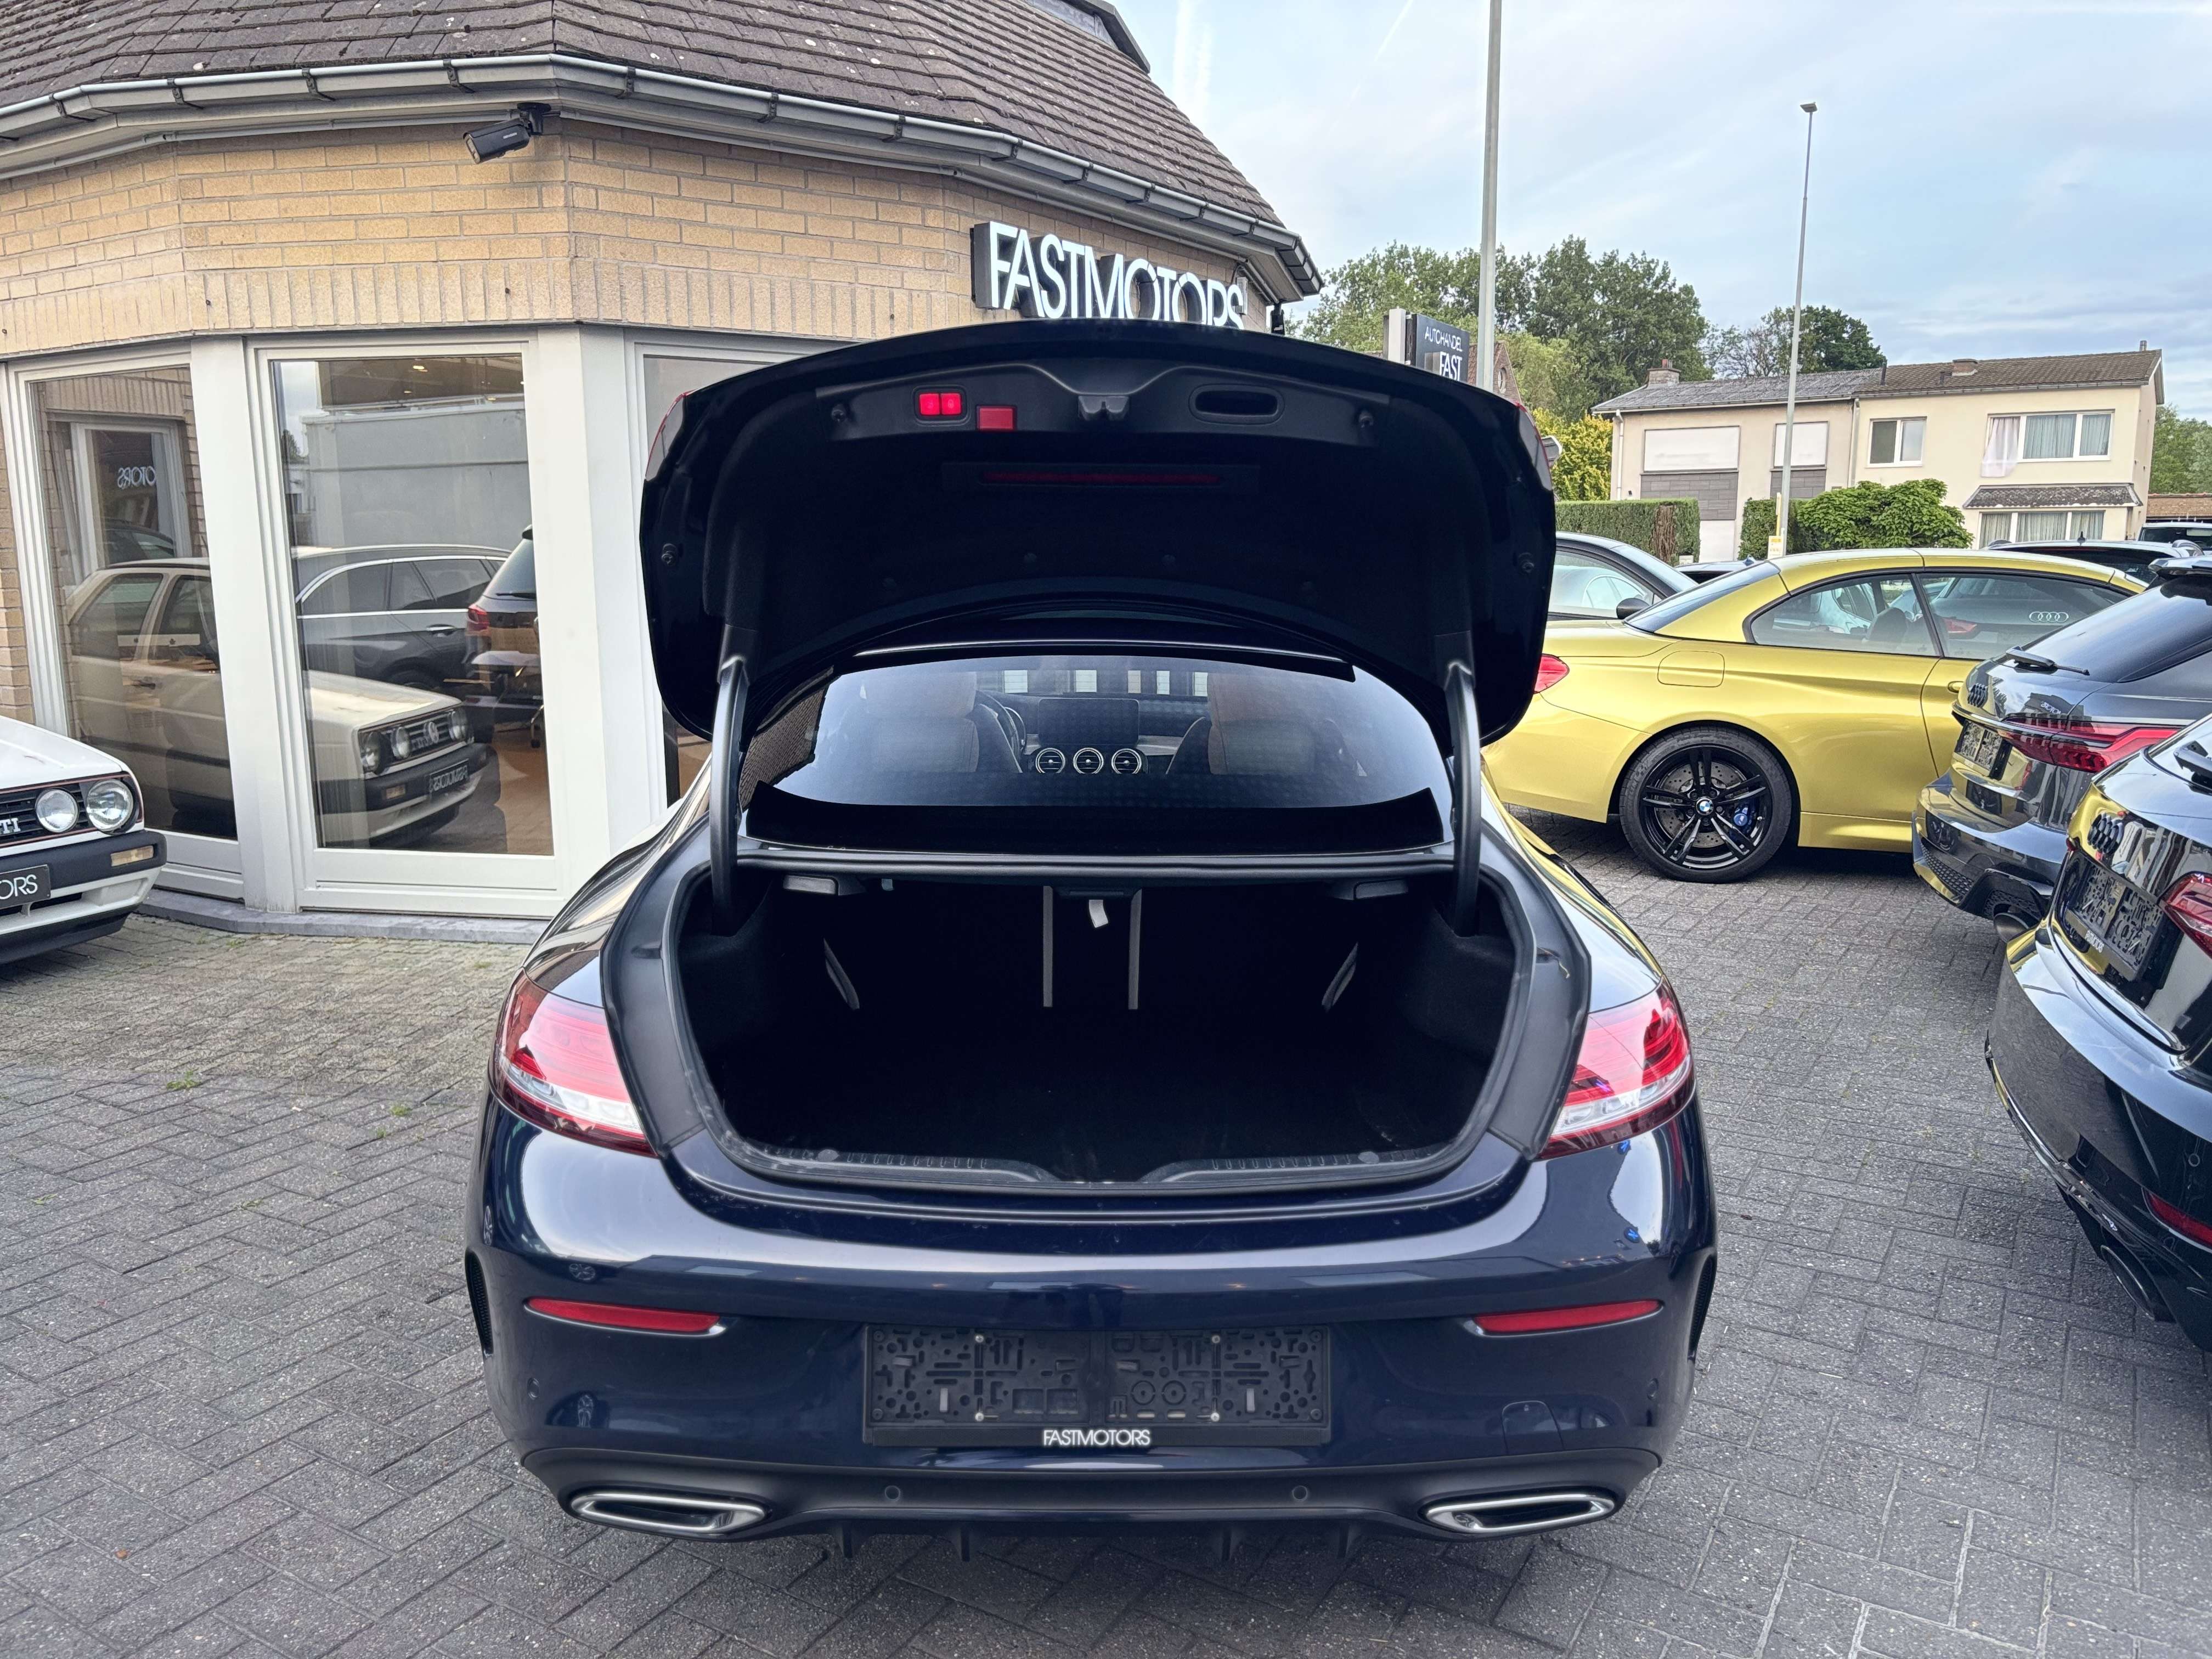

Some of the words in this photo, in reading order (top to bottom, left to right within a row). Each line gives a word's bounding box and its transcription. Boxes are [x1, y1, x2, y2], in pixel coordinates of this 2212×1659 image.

[989, 221, 1244, 330] FASTMOTORS
[1439, 351, 1463, 382] FAST
[1043, 1429, 1150, 1446] FASTMOTORS
